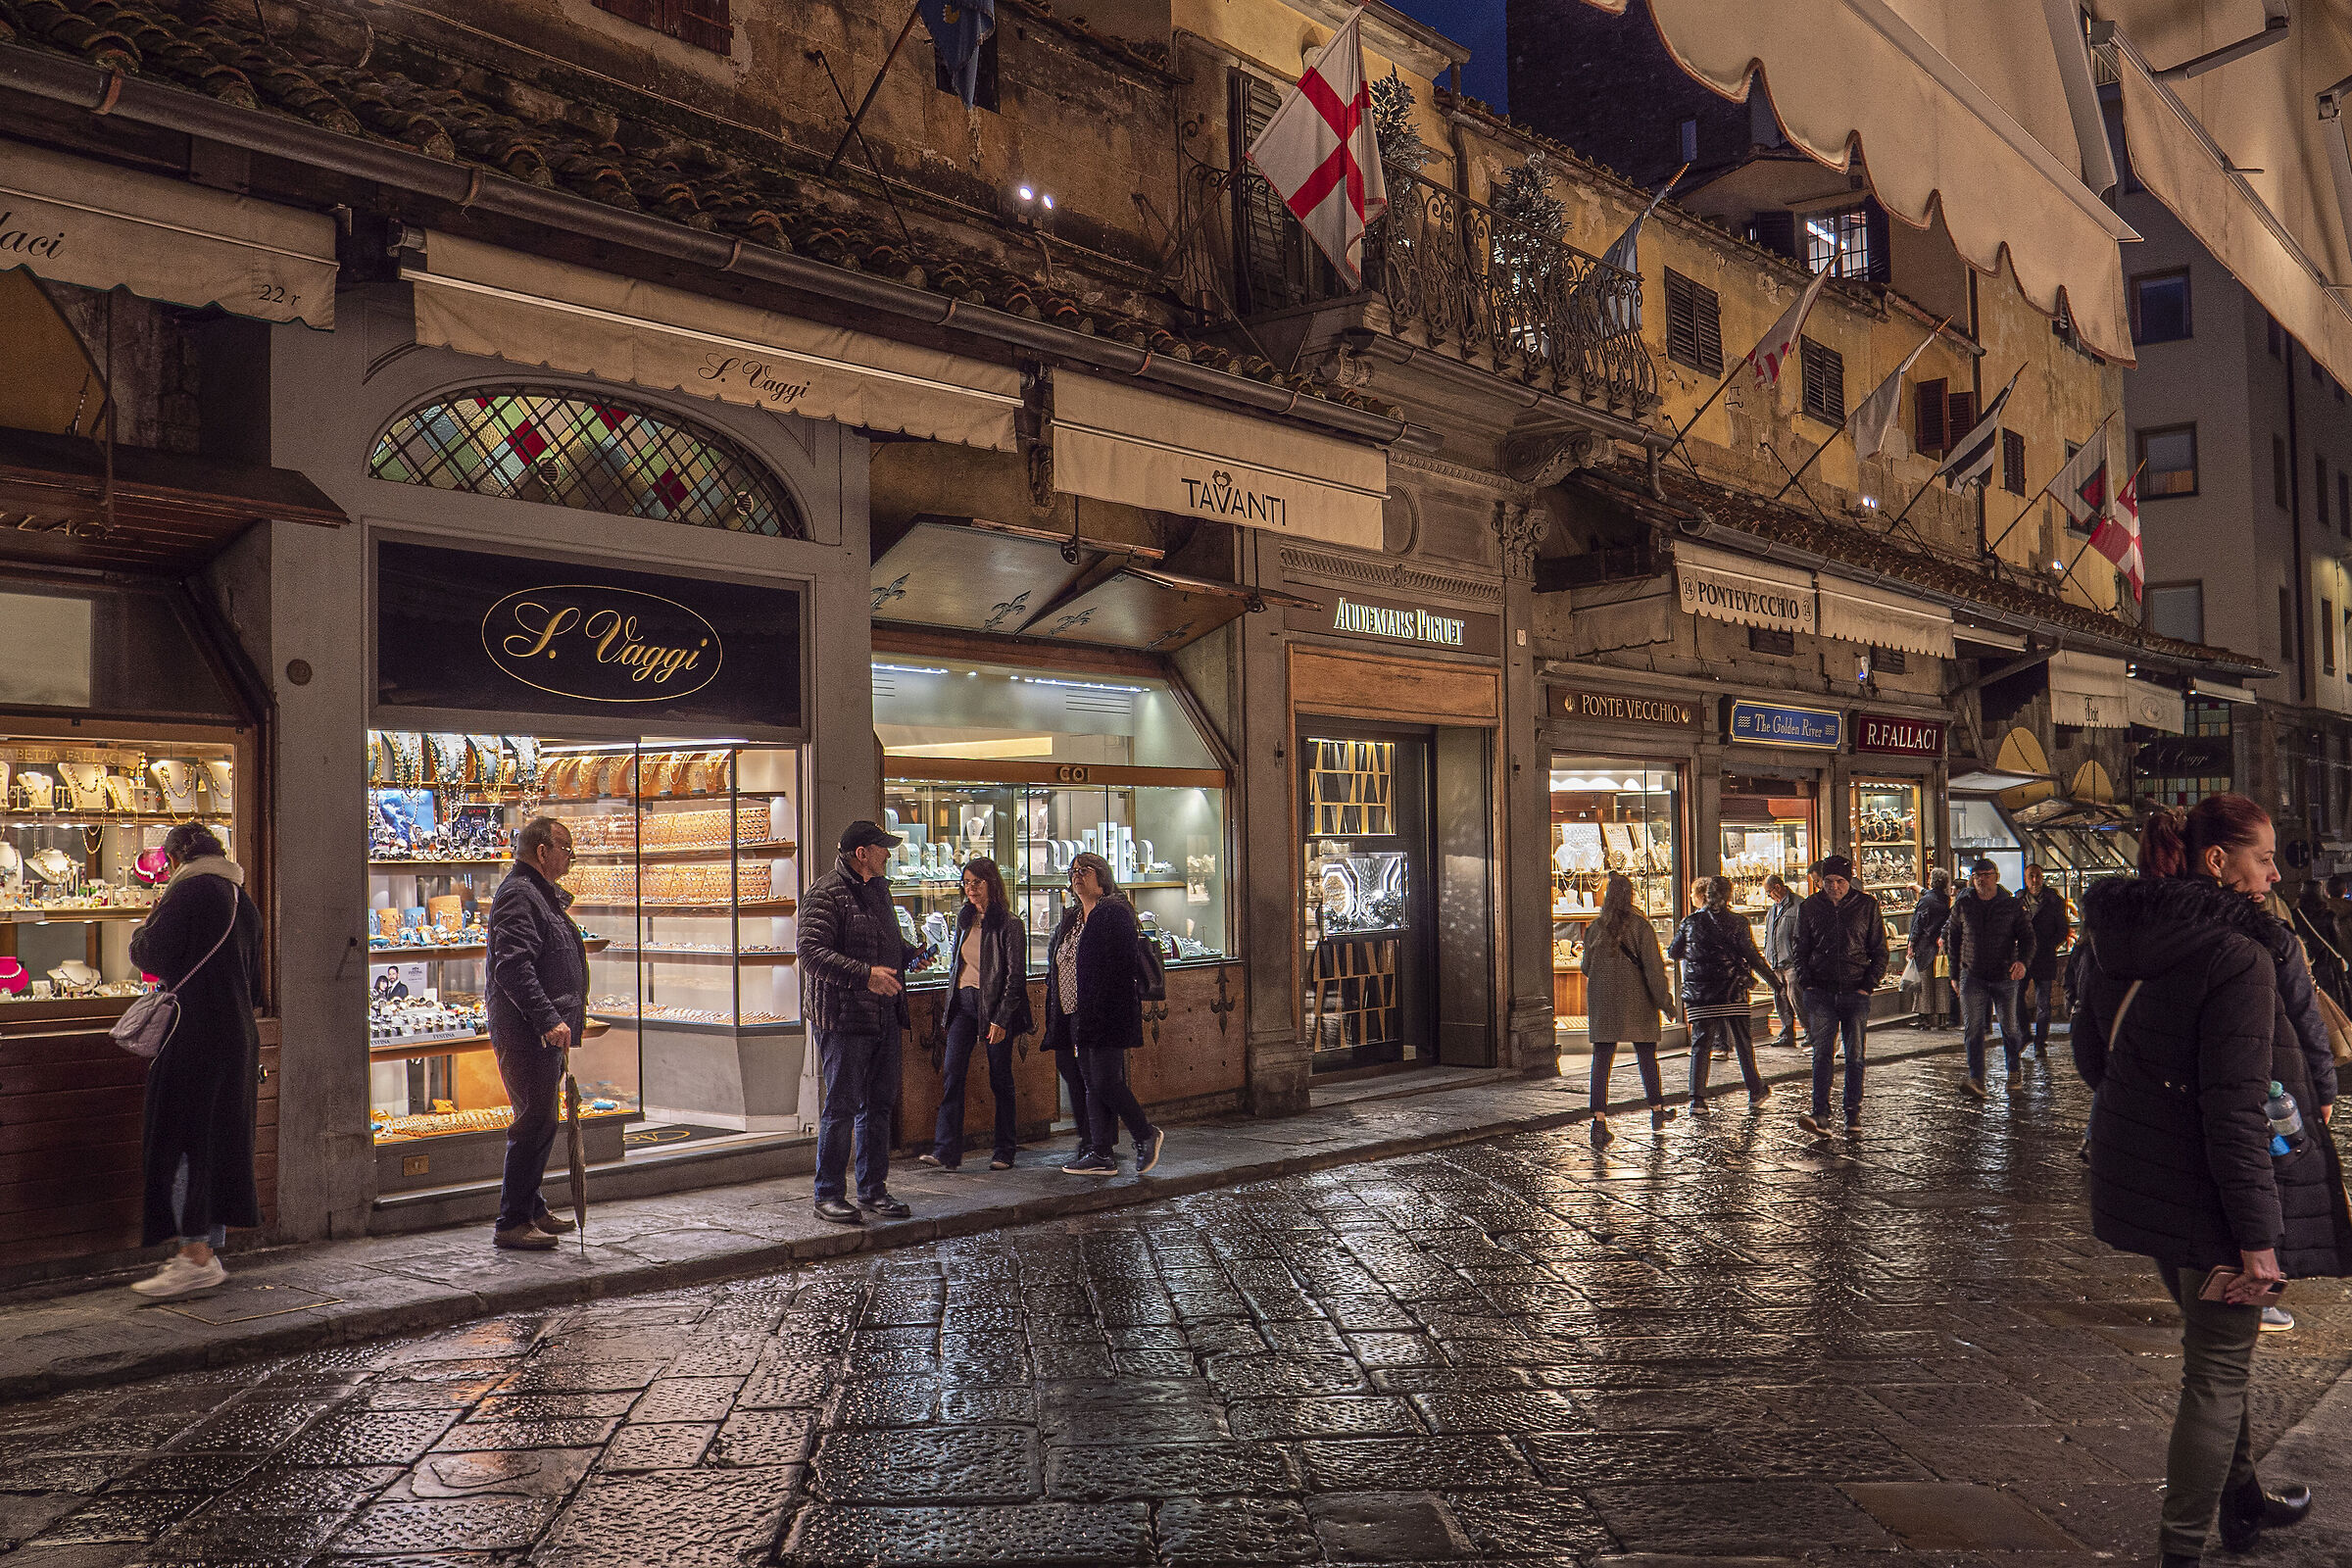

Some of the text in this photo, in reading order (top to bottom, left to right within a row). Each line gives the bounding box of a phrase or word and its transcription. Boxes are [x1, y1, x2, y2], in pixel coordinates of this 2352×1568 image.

[258, 283, 302, 307] 22 r
[697, 352, 811, 405] S. Vaggi
[1180, 477, 1287, 526] TAVANTI
[1697, 580, 1800, 619] PONTEVECCHIO
[1333, 597, 1465, 646] AUDEMARS PIGUET
[503, 602, 709, 684] S. Vaggi
[1581, 694, 1624, 717] PONTE
[1626, 699, 1681, 724] VECCHIO
[1754, 713, 1823, 738] The Golden River
[66, 750, 122, 764] FALLACI
